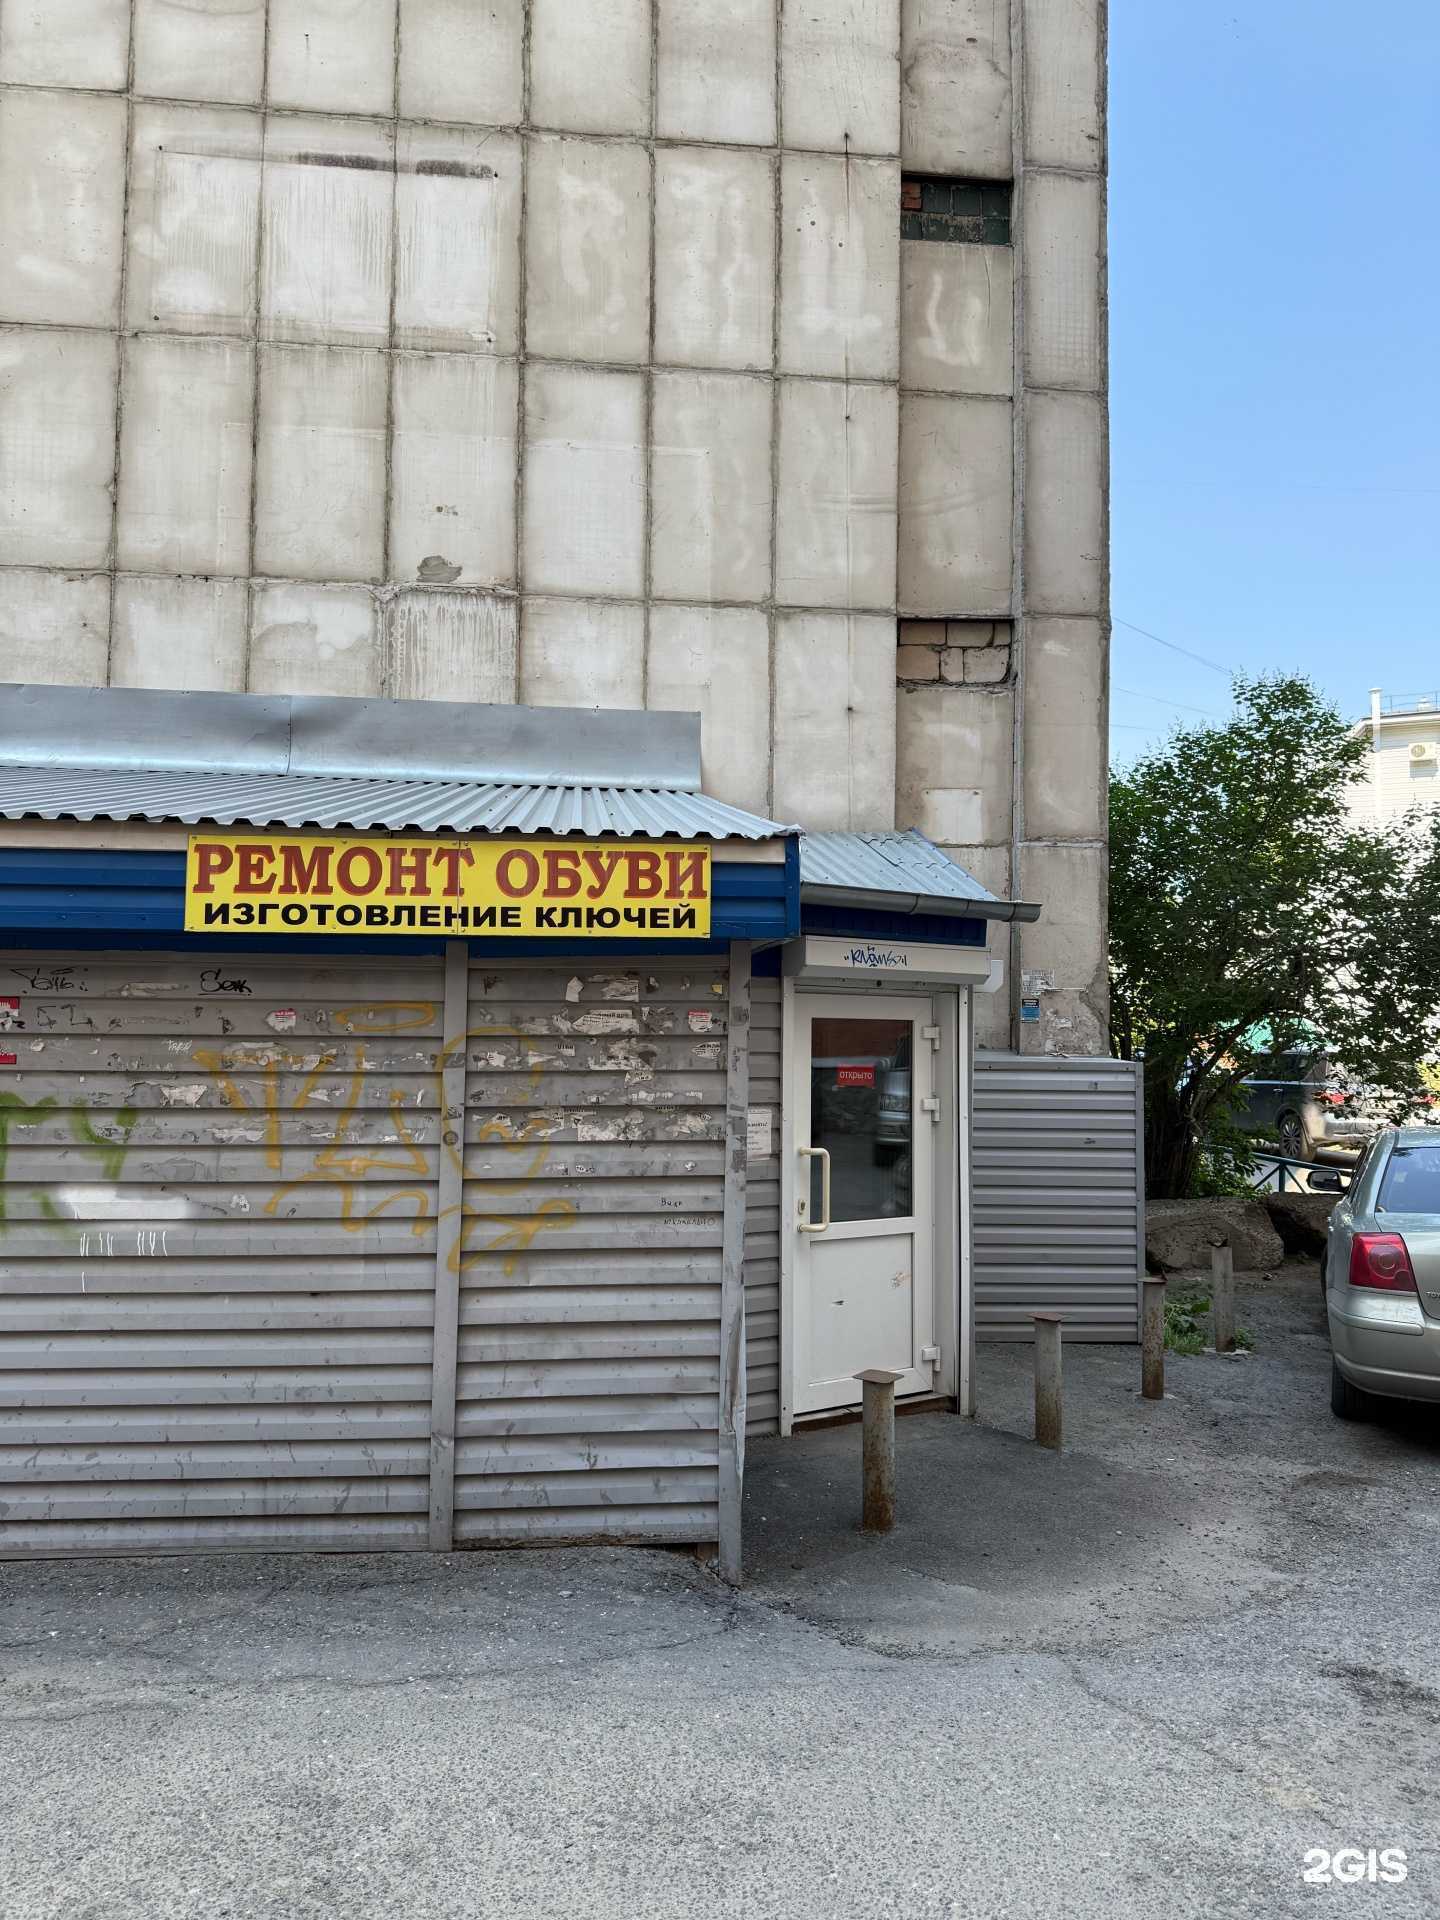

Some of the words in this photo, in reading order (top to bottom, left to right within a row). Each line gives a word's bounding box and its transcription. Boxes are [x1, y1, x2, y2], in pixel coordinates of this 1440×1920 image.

[192, 843, 476, 897] РЕМОНТ
[495, 848, 708, 899] ОБУВИ
[204, 902, 521, 928] ИЗГОТОВЛЕНИЕ
[535, 903, 696, 929] КЛЮЧЕЙ
